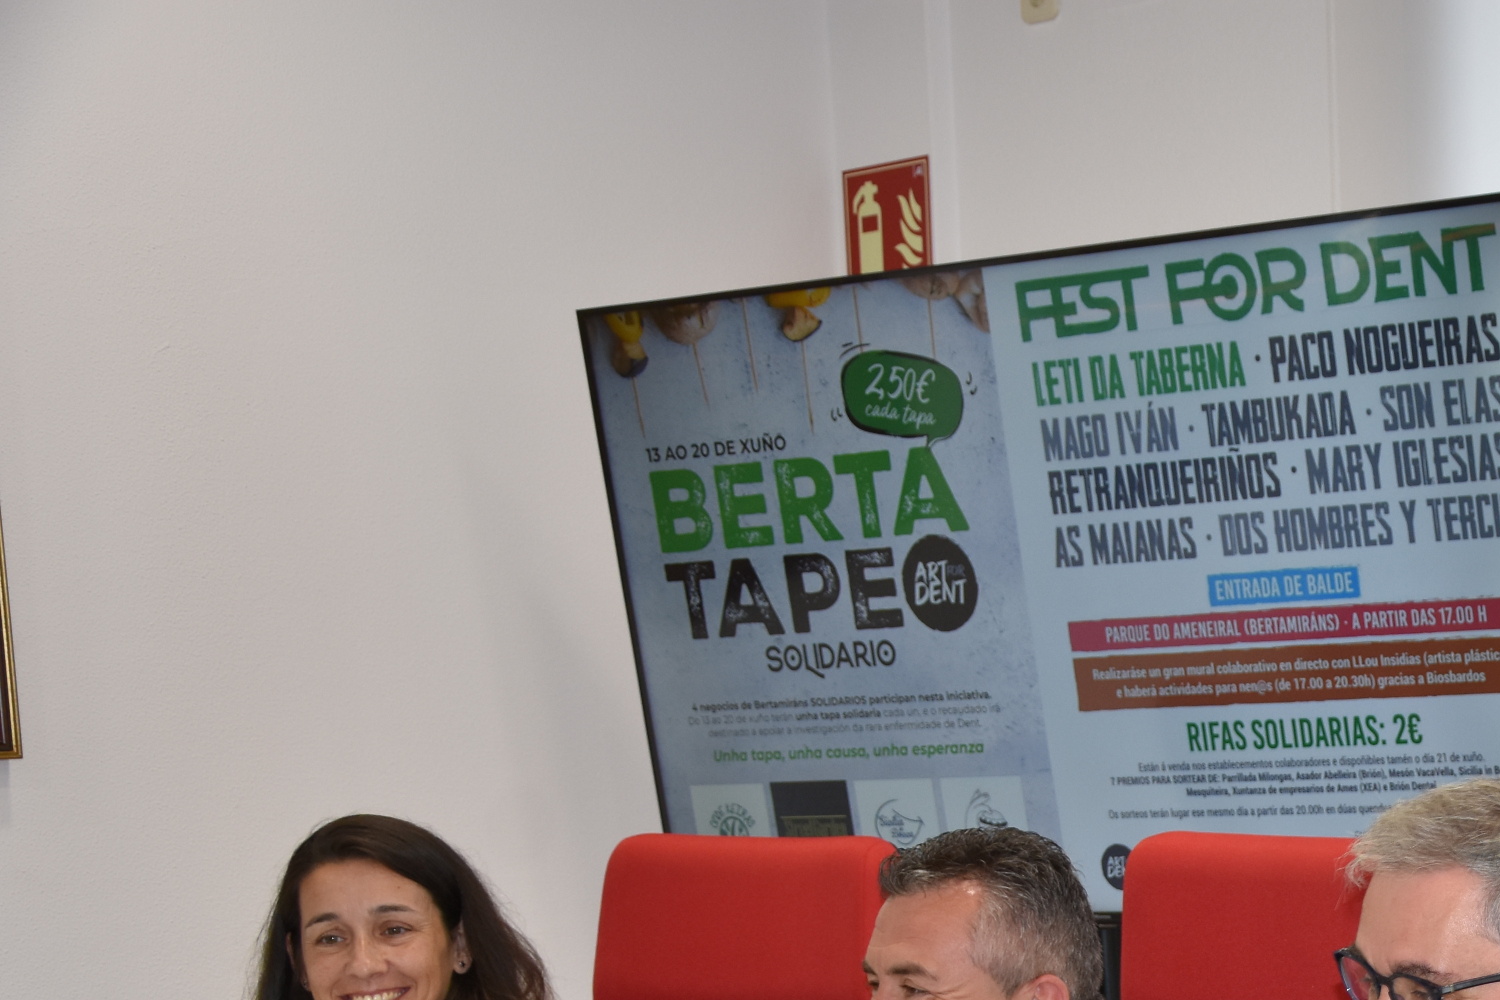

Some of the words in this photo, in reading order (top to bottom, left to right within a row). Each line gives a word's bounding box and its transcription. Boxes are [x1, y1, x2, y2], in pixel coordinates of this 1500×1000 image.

[1015, 265, 1149, 342] FEST
[1165, 247, 1307, 325] FOR
[1321, 223, 1496, 306] DENT
[1032, 356, 1085, 407] LETI
[1088, 354, 1126, 401] DA
[1129, 340, 1246, 398] TABERNA
[1269, 329, 1338, 383] PACO
[865, 401, 900, 420] cada
[902, 404, 938, 430] tapa
[1040, 415, 1110, 462] MAGO
[1115, 401, 1179, 456] IVÁN
[1202, 388, 1357, 448] TAMBUKADA
[1380, 386, 1434, 432] SON
[646, 447, 661, 463] 13
[665, 443, 688, 461] AO
[691, 442, 710, 459] 20
[714, 440, 736, 456] DE
[738, 432, 788, 454] XUÑO
[1047, 447, 1282, 515] RETRANQUEIRIÑOS
[1305, 443, 1383, 495] MARY
[648, 446, 970, 553] BERTA
[1055, 524, 1084, 568] AS
[1088, 517, 1197, 566] MAIANAS
[1218, 511, 1268, 557] DOS
[1275, 501, 1394, 554] HOMBRES
[1399, 500, 1417, 544] Y
[914, 560, 948, 582] ART
[1214, 576, 1281, 600] ENTRADA
[1284, 575, 1304, 596] DE
[1307, 571, 1354, 595] BALDE
[914, 579, 967, 606] DENT
[1105, 624, 1151, 643] PARQUE
[1153, 623, 1170, 641] DO
[1172, 619, 1241, 640] AMENEIRAL
[1244, 611, 1340, 636] (BERTAMIRÁNS)
[1352, 612, 1361, 629] A
[1364, 610, 1407, 629] PARTIR
[1411, 608, 1436, 626] DAS
[1439, 606, 1474, 625] 17.00
[1477, 605, 1488, 622] H
[766, 639, 897, 679] SOLIDARIO
[1092, 667, 1147, 681] Realizaráse
[1149, 667, 1161, 677] un
[1164, 666, 1185, 680] gran
[1187, 663, 1215, 676] mural
[1216, 660, 1277, 674] colaborativo
[1279, 660, 1292, 672] en
[1294, 658, 1329, 671] directo
[1331, 658, 1350, 669] con
[1352, 656, 1378, 668] LLou
[1380, 652, 1421, 667] Insidias
[1423, 650, 1461, 667] (artista
[1116, 688, 1122, 697] e
[1124, 683, 1157, 697] haberá
[1158, 682, 1214, 696] actividades
[1215, 683, 1237, 696] para
[1239, 680, 1273, 694] nen@s
[1275, 678, 1292, 692] (de
[1294, 677, 1323, 690] 17.00
[1325, 680, 1333, 688] a
[1334, 674, 1375, 689] 20.30h)
[1378, 675, 1415, 690] gracias
[1417, 676, 1425, 685] a
[1427, 670, 1487, 684] Biosbardos
[1186, 720, 1247, 752] RIFAS
[1251, 714, 1387, 751] SOLIDARIAS:
[1392, 713, 1423, 745] 2€
[713, 749, 748, 762] Unha
[751, 748, 785, 763] tapa,
[788, 745, 822, 760] unha
[826, 746, 869, 760] causa,
[873, 743, 908, 757] unha
[912, 742, 984, 758] esperanza
